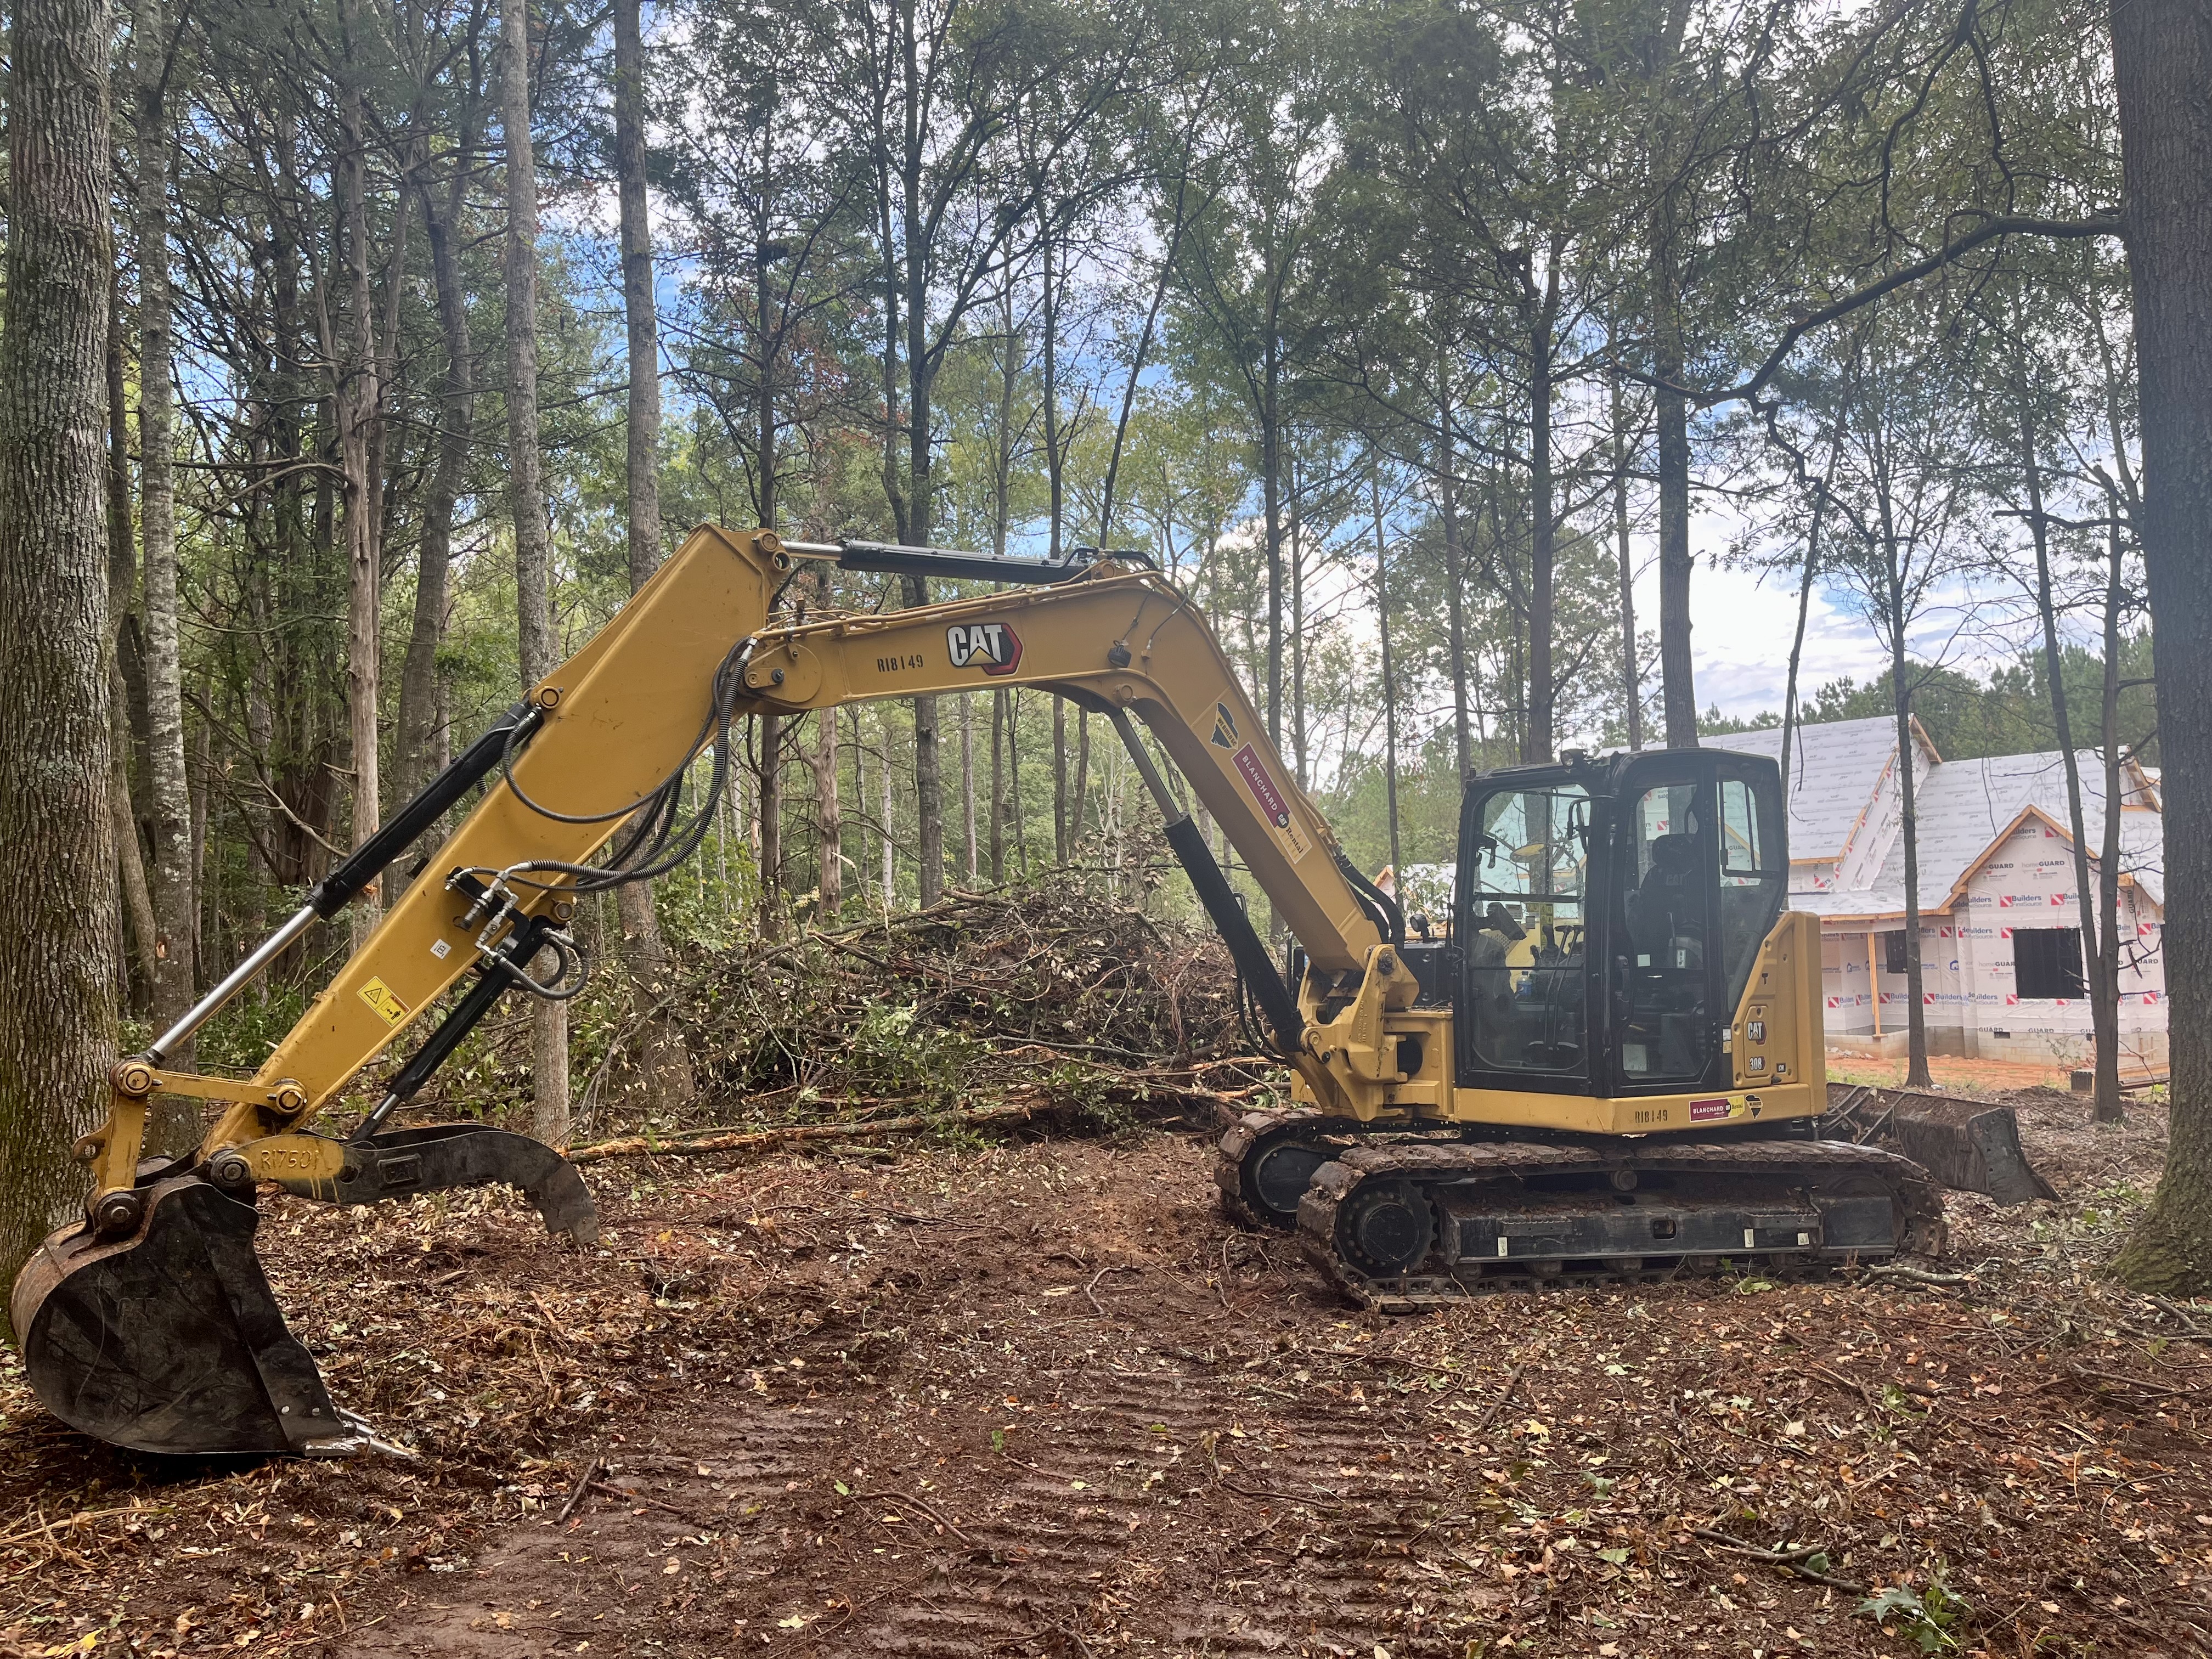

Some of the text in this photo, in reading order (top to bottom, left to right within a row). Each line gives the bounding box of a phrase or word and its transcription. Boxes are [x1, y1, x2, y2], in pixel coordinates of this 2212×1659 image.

[947, 624, 1002, 666] CAT
[877, 654, 923, 673] R18149
[1242, 755, 1278, 811] BLANCHARD
[1278, 814, 1288, 826] CAT
[1285, 827, 1304, 854] Rental
[1748, 1022, 1762, 1040] CAT
[1750, 1057, 1762, 1070] 308
[1635, 1109, 1668, 1124] R18149
[1693, 1105, 1724, 1114] BLANCHARD
